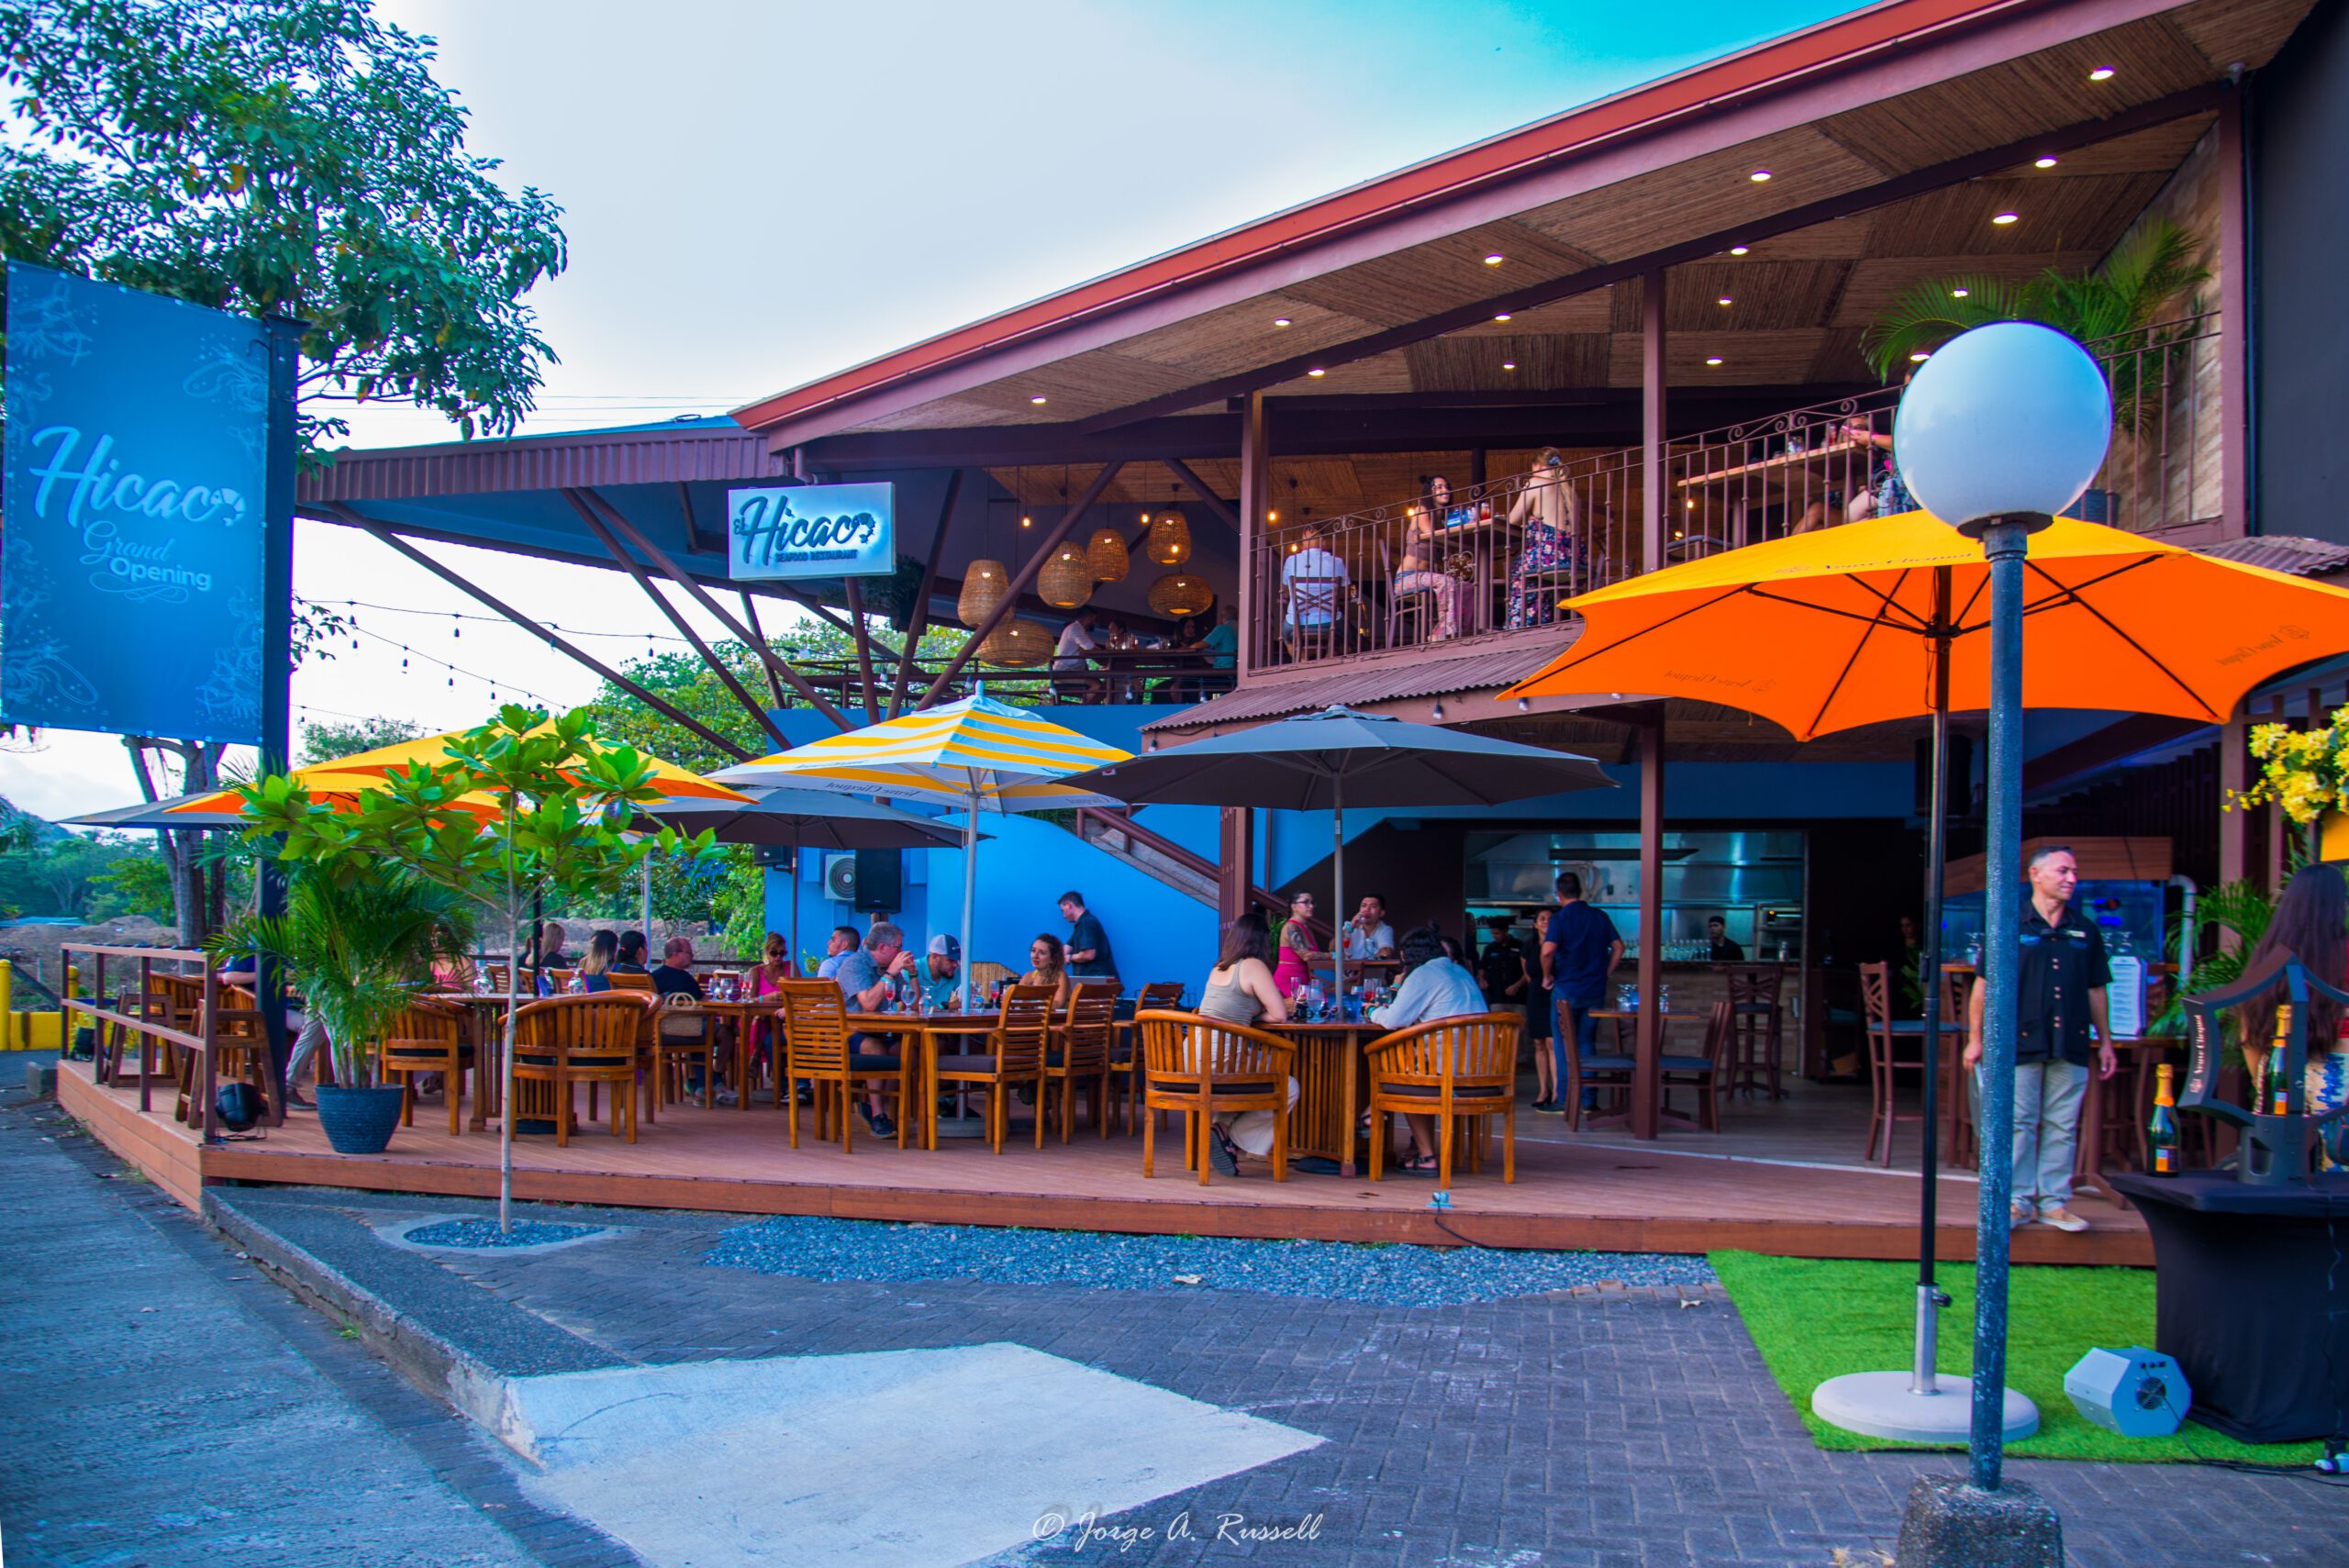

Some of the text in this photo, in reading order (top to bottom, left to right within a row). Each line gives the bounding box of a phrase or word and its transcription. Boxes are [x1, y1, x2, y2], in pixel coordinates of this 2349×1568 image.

[79, 520, 176, 565] Grand
[775, 550, 858, 562] SEAFOOD RESTAURANT
[109, 557, 213, 593] Opening
